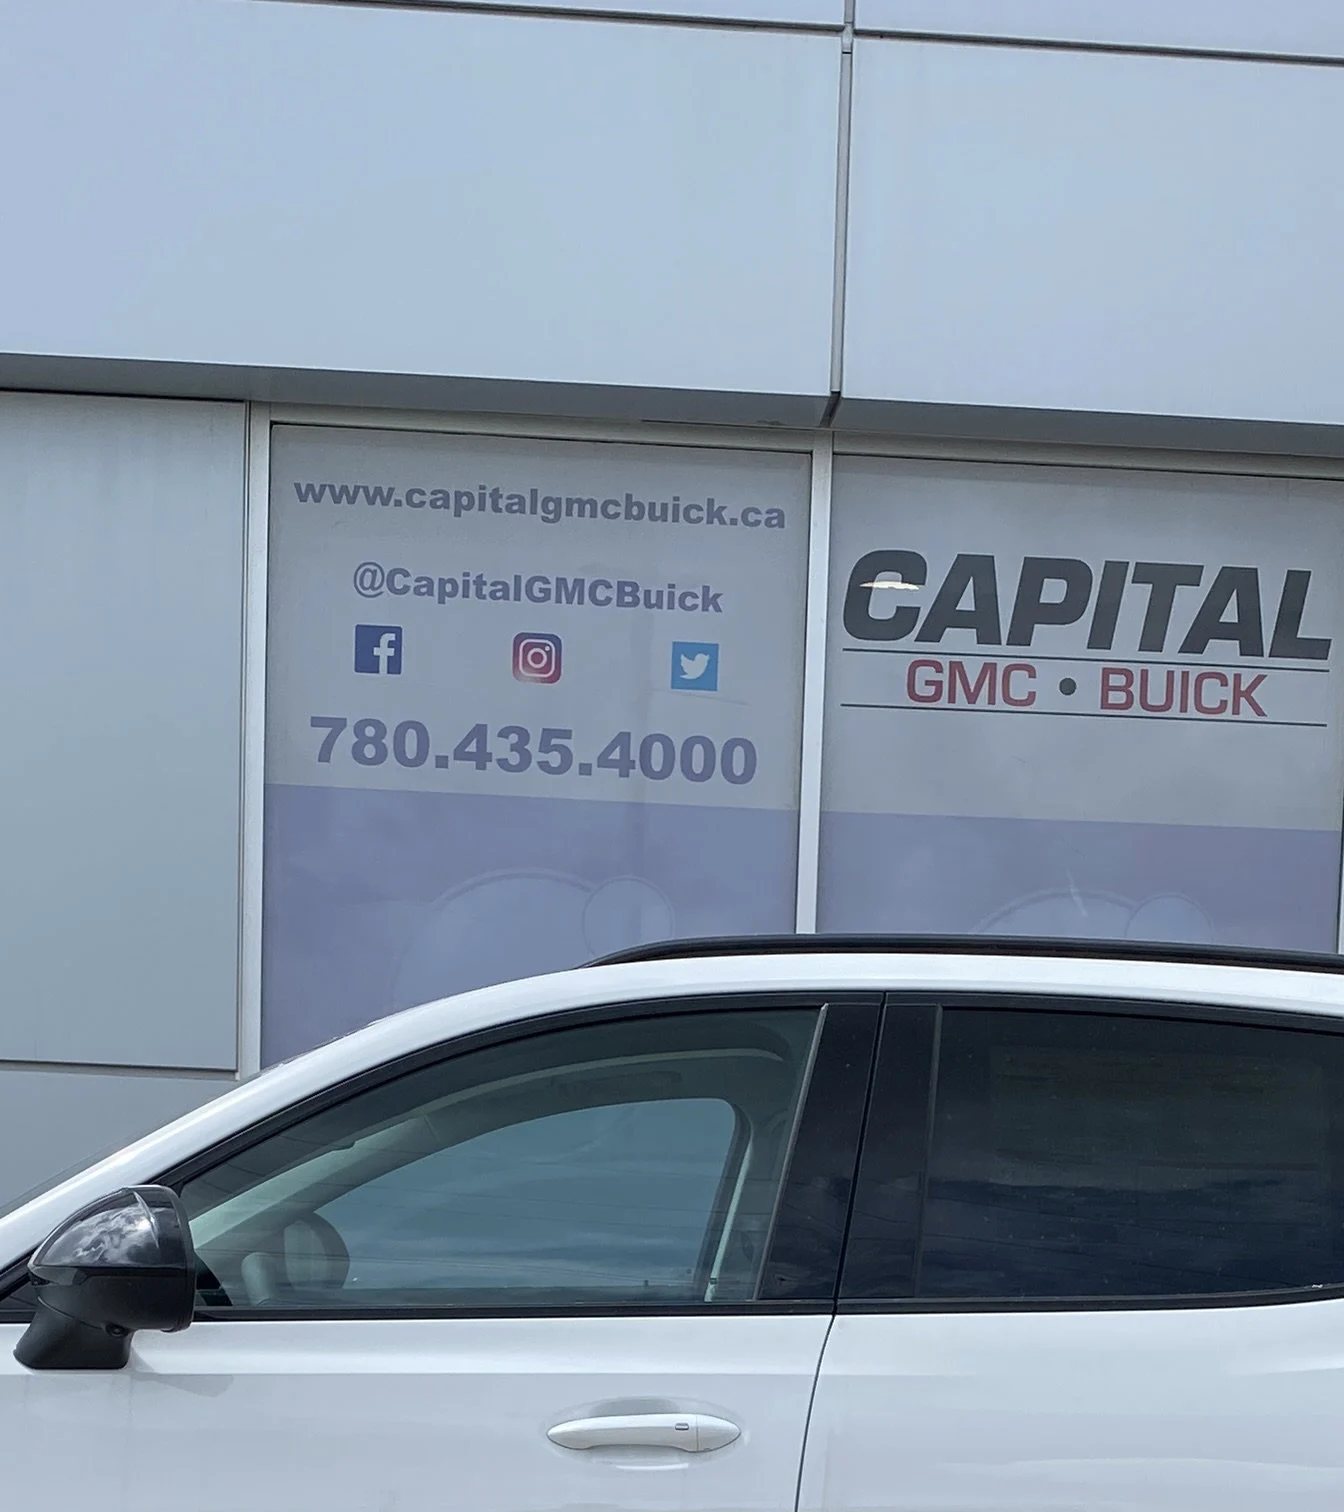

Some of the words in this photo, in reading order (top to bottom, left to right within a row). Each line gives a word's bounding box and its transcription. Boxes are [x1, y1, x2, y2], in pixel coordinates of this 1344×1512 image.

[293, 480, 787, 529] www.capitalgmcbuick.ca
[353, 561, 724, 614] @CapitalGMCBuick
[842, 549, 1333, 661] CAPITAL
[906, 658, 1037, 707] GMC
[1100, 667, 1268, 717] BUICK
[310, 716, 758, 785] 780.435.4000
